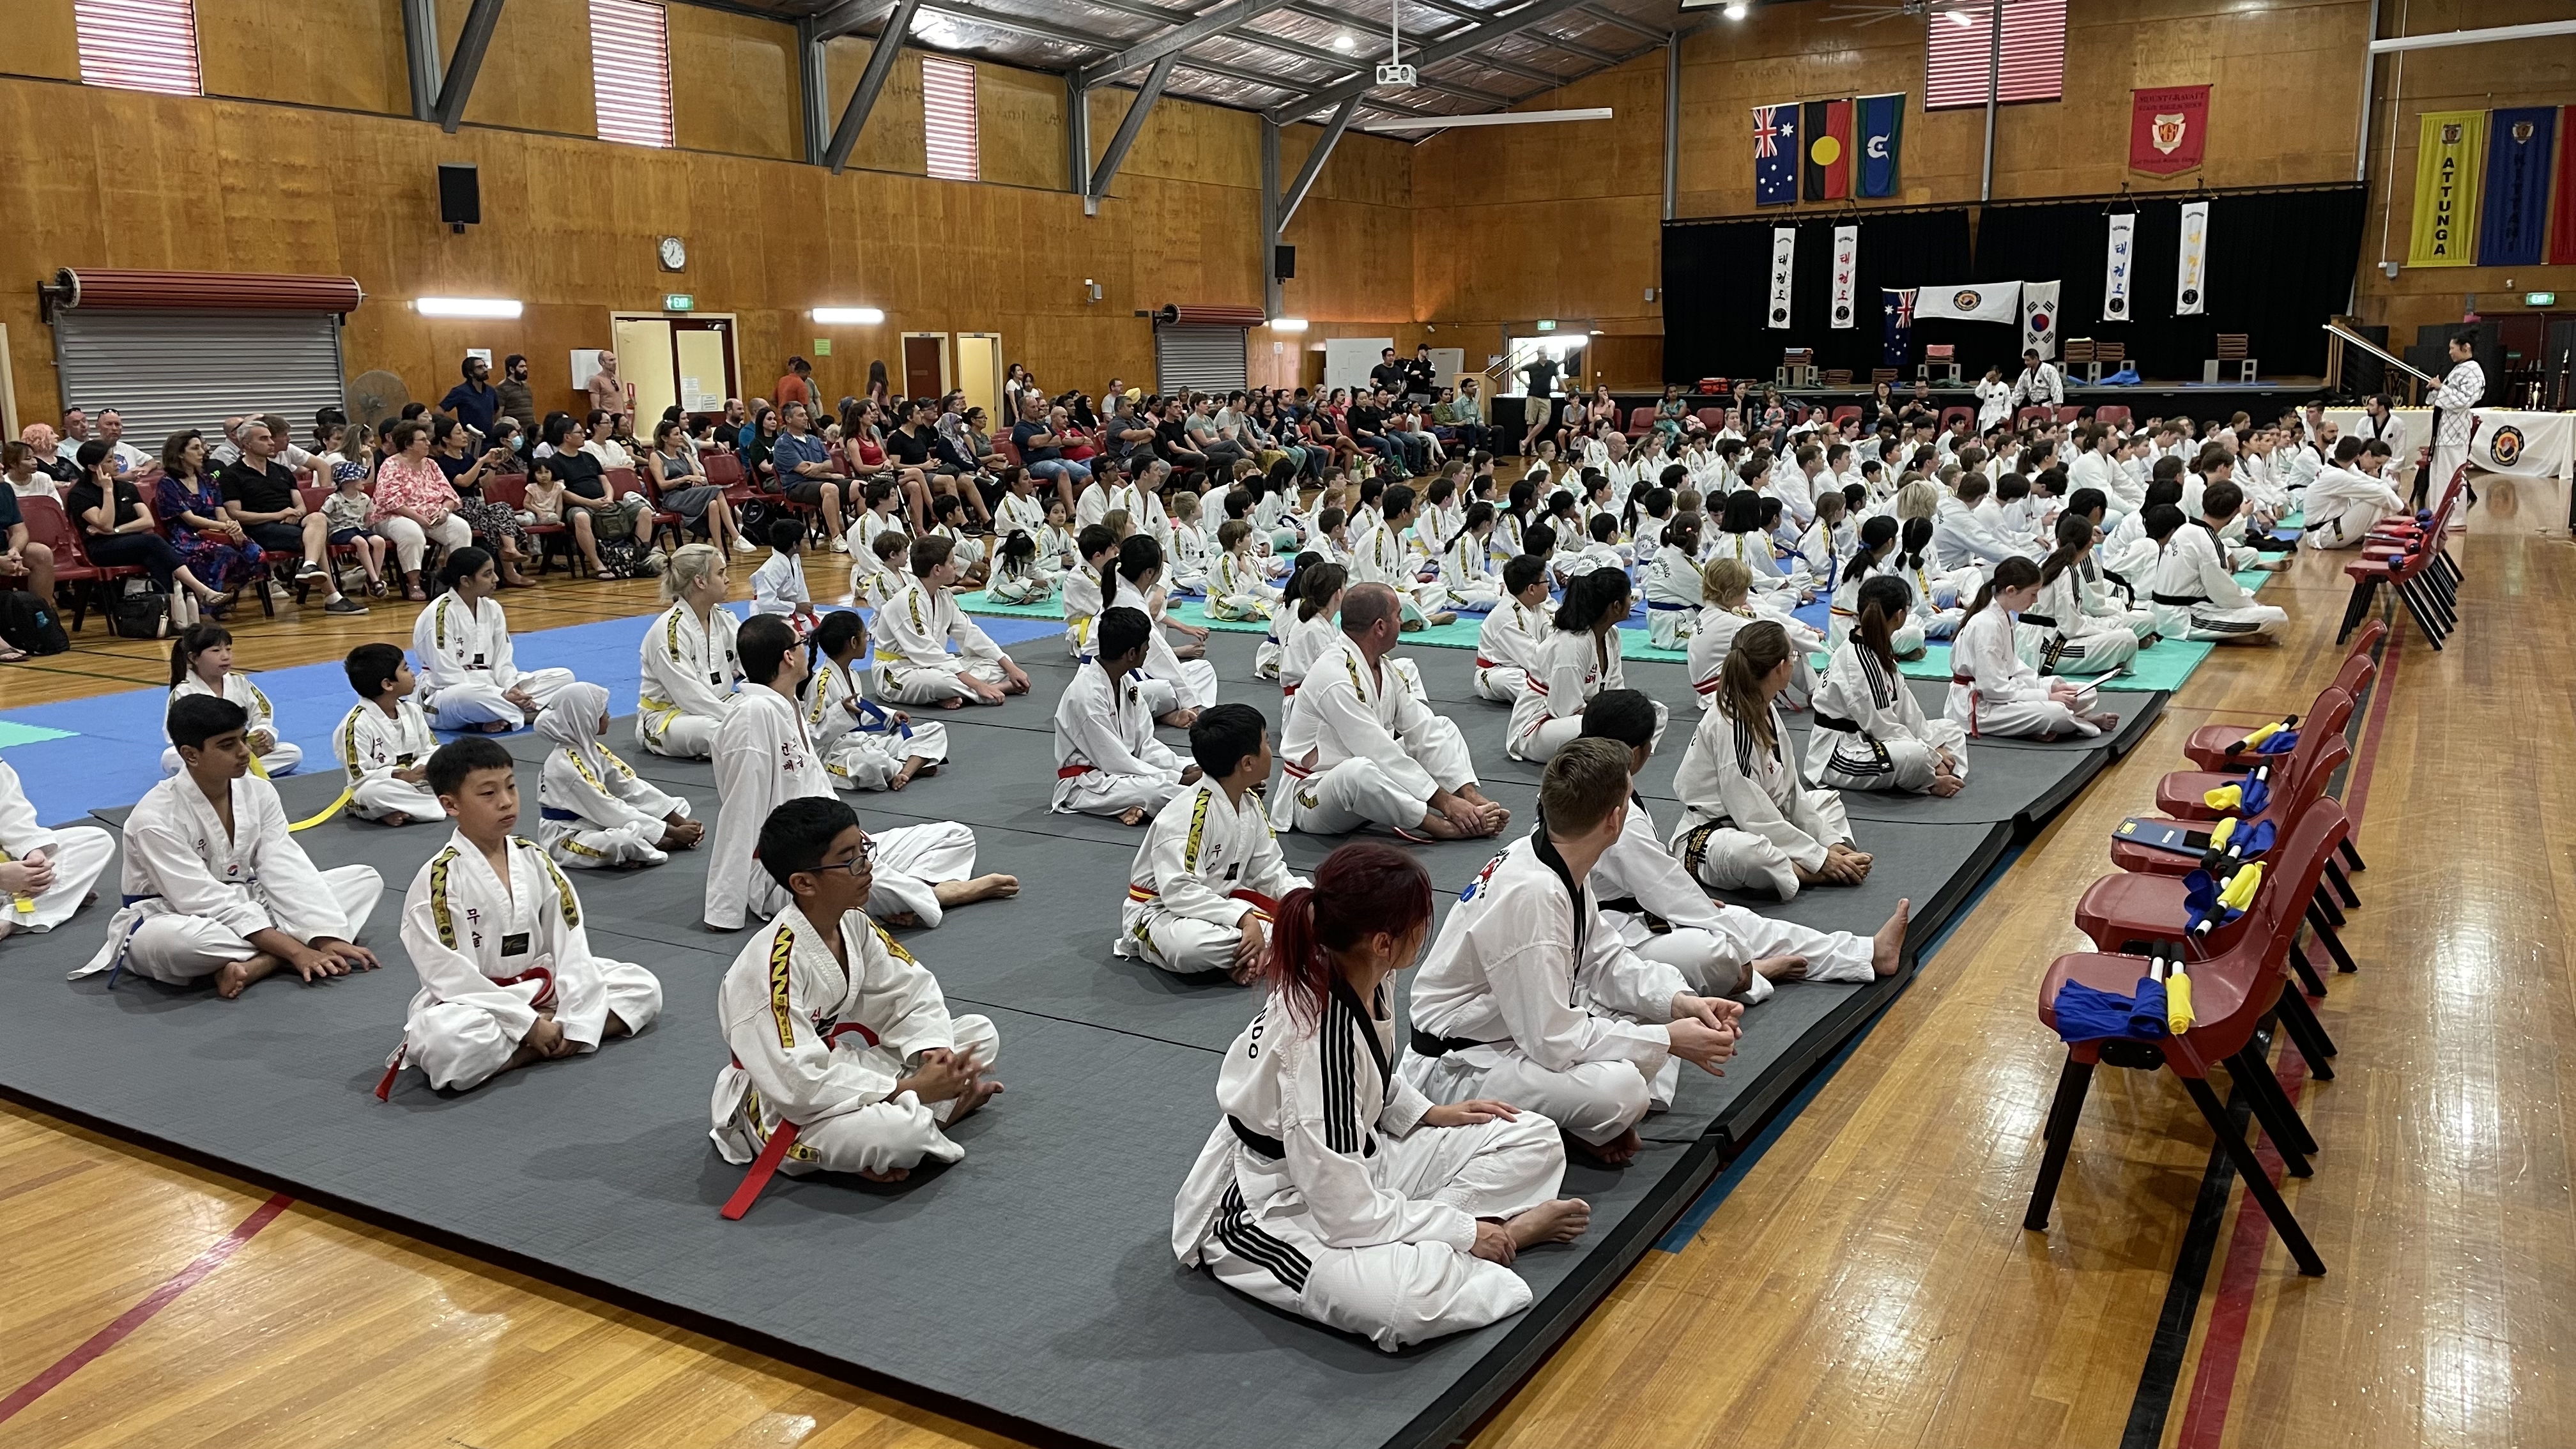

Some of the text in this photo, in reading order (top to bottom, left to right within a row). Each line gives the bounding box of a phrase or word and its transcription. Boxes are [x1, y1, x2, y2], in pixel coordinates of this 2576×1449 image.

[2434, 157, 2455, 256] ATTUNGA
[673, 297, 689, 308] EXIT
[2531, 294, 2549, 303] EXIT
